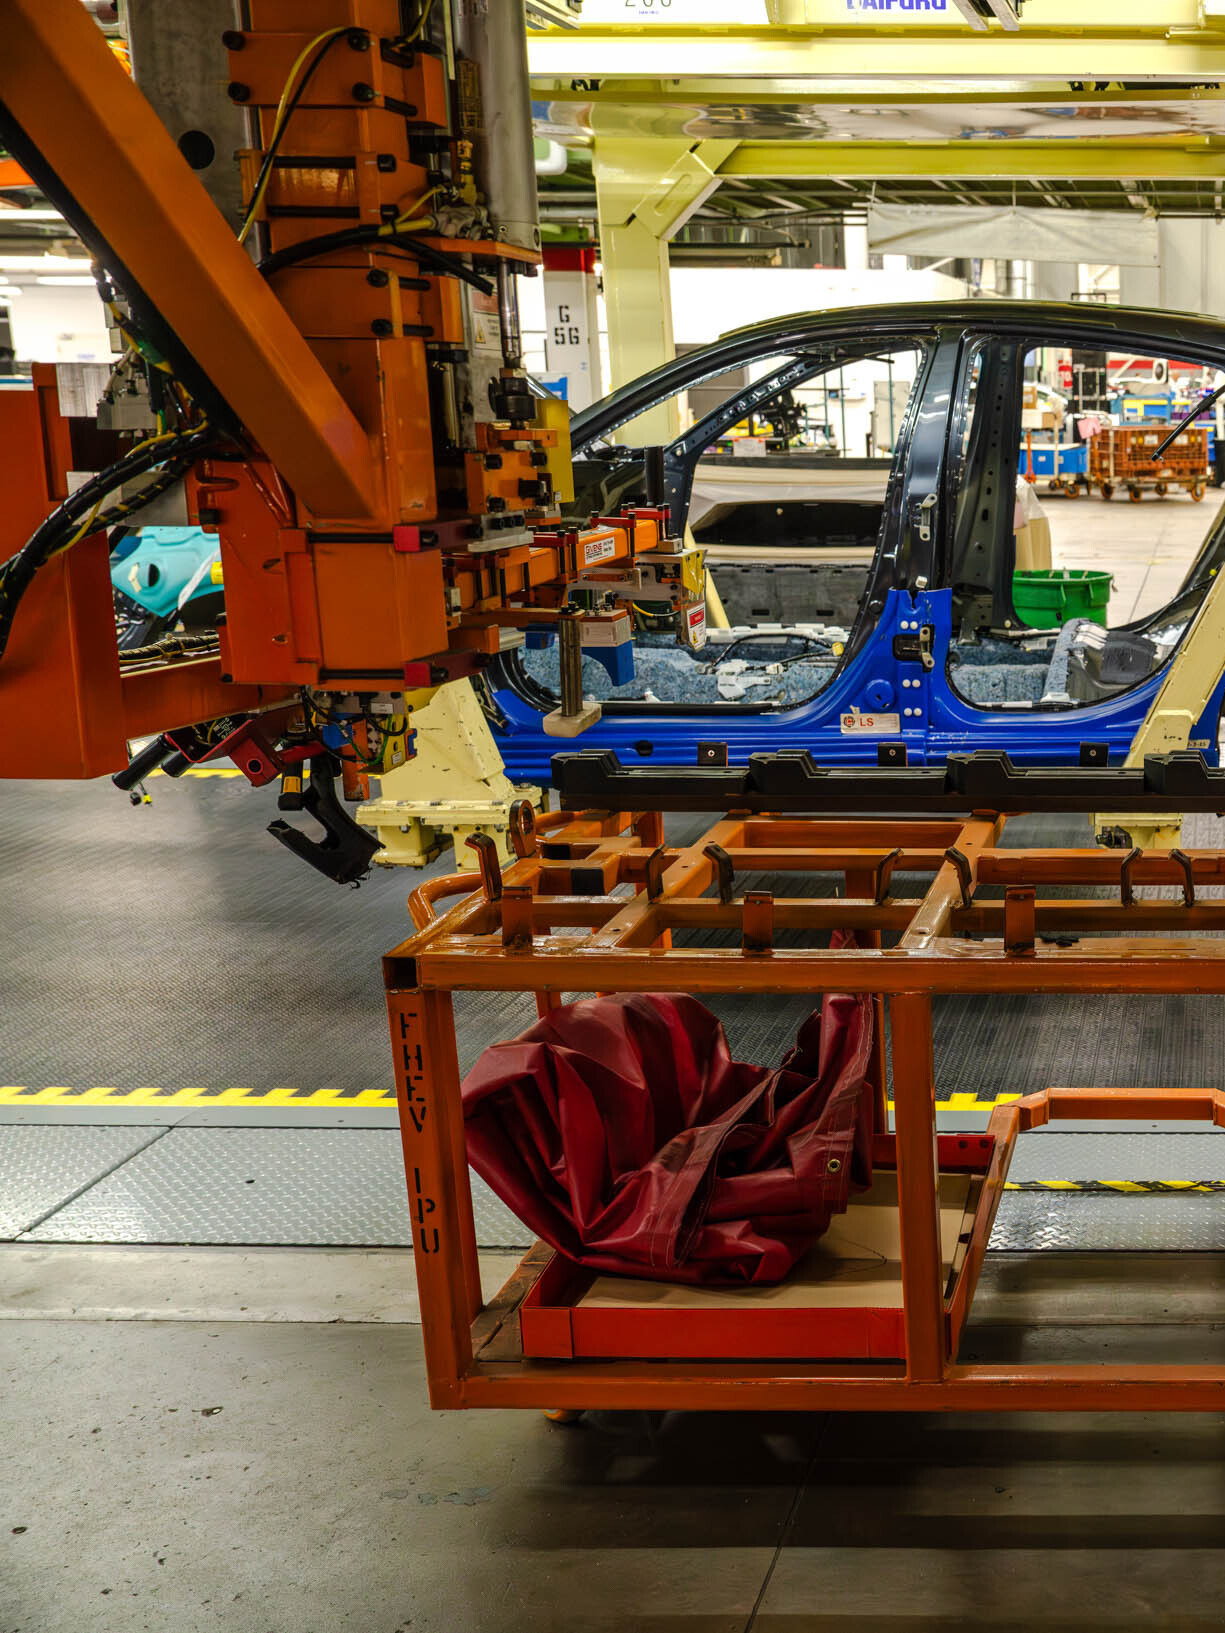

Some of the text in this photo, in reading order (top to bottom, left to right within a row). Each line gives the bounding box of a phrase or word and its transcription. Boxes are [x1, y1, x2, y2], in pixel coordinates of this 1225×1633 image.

[558, 304, 570, 323] G
[860, 717, 874, 727] LS
[400, 1012, 440, 1254] FHEV IPU
